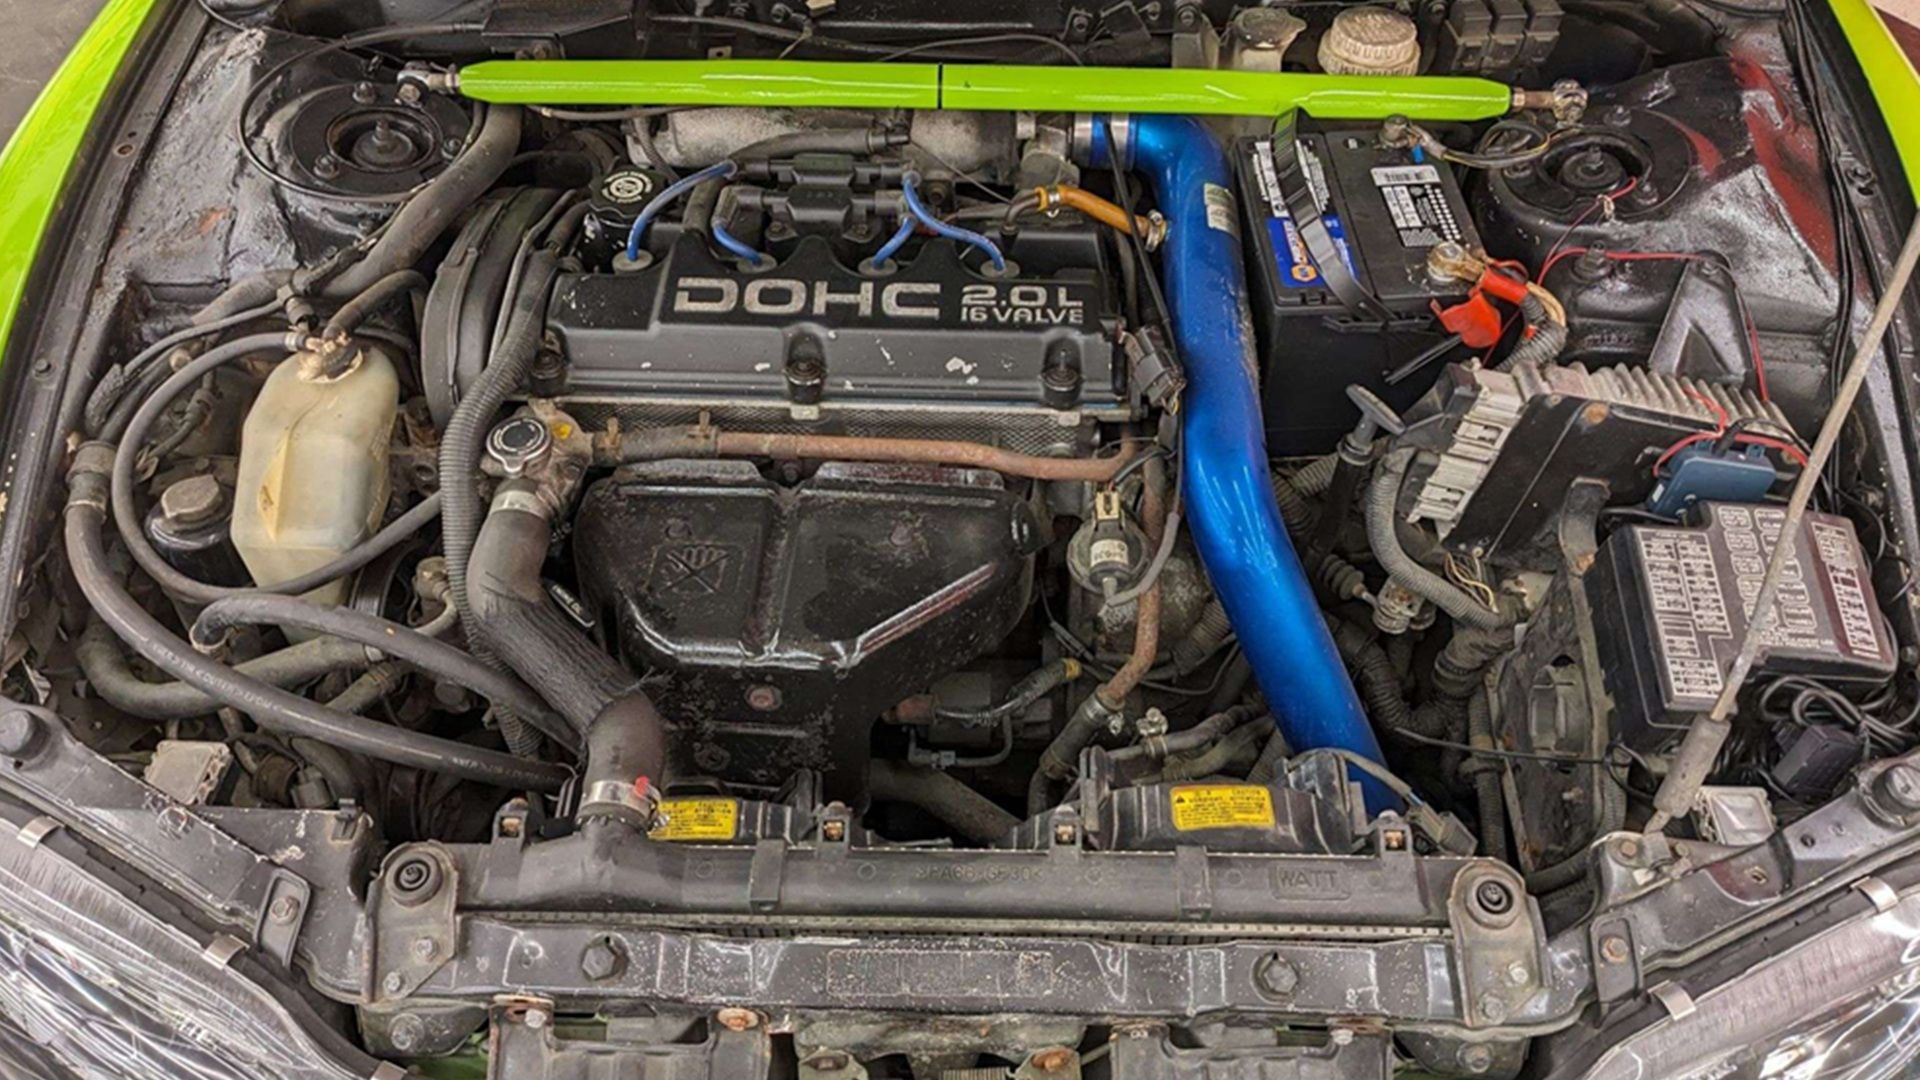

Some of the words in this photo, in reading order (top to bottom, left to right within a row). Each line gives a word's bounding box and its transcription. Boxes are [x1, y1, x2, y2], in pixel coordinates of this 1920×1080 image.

[674, 276, 941, 319] DOHC
[961, 284, 1048, 307] 2.0
[1057, 286, 1084, 307] L
[960, 307, 989, 322] 16
[991, 307, 1084, 324] VALVE
[1278, 869, 1338, 888] WATT
